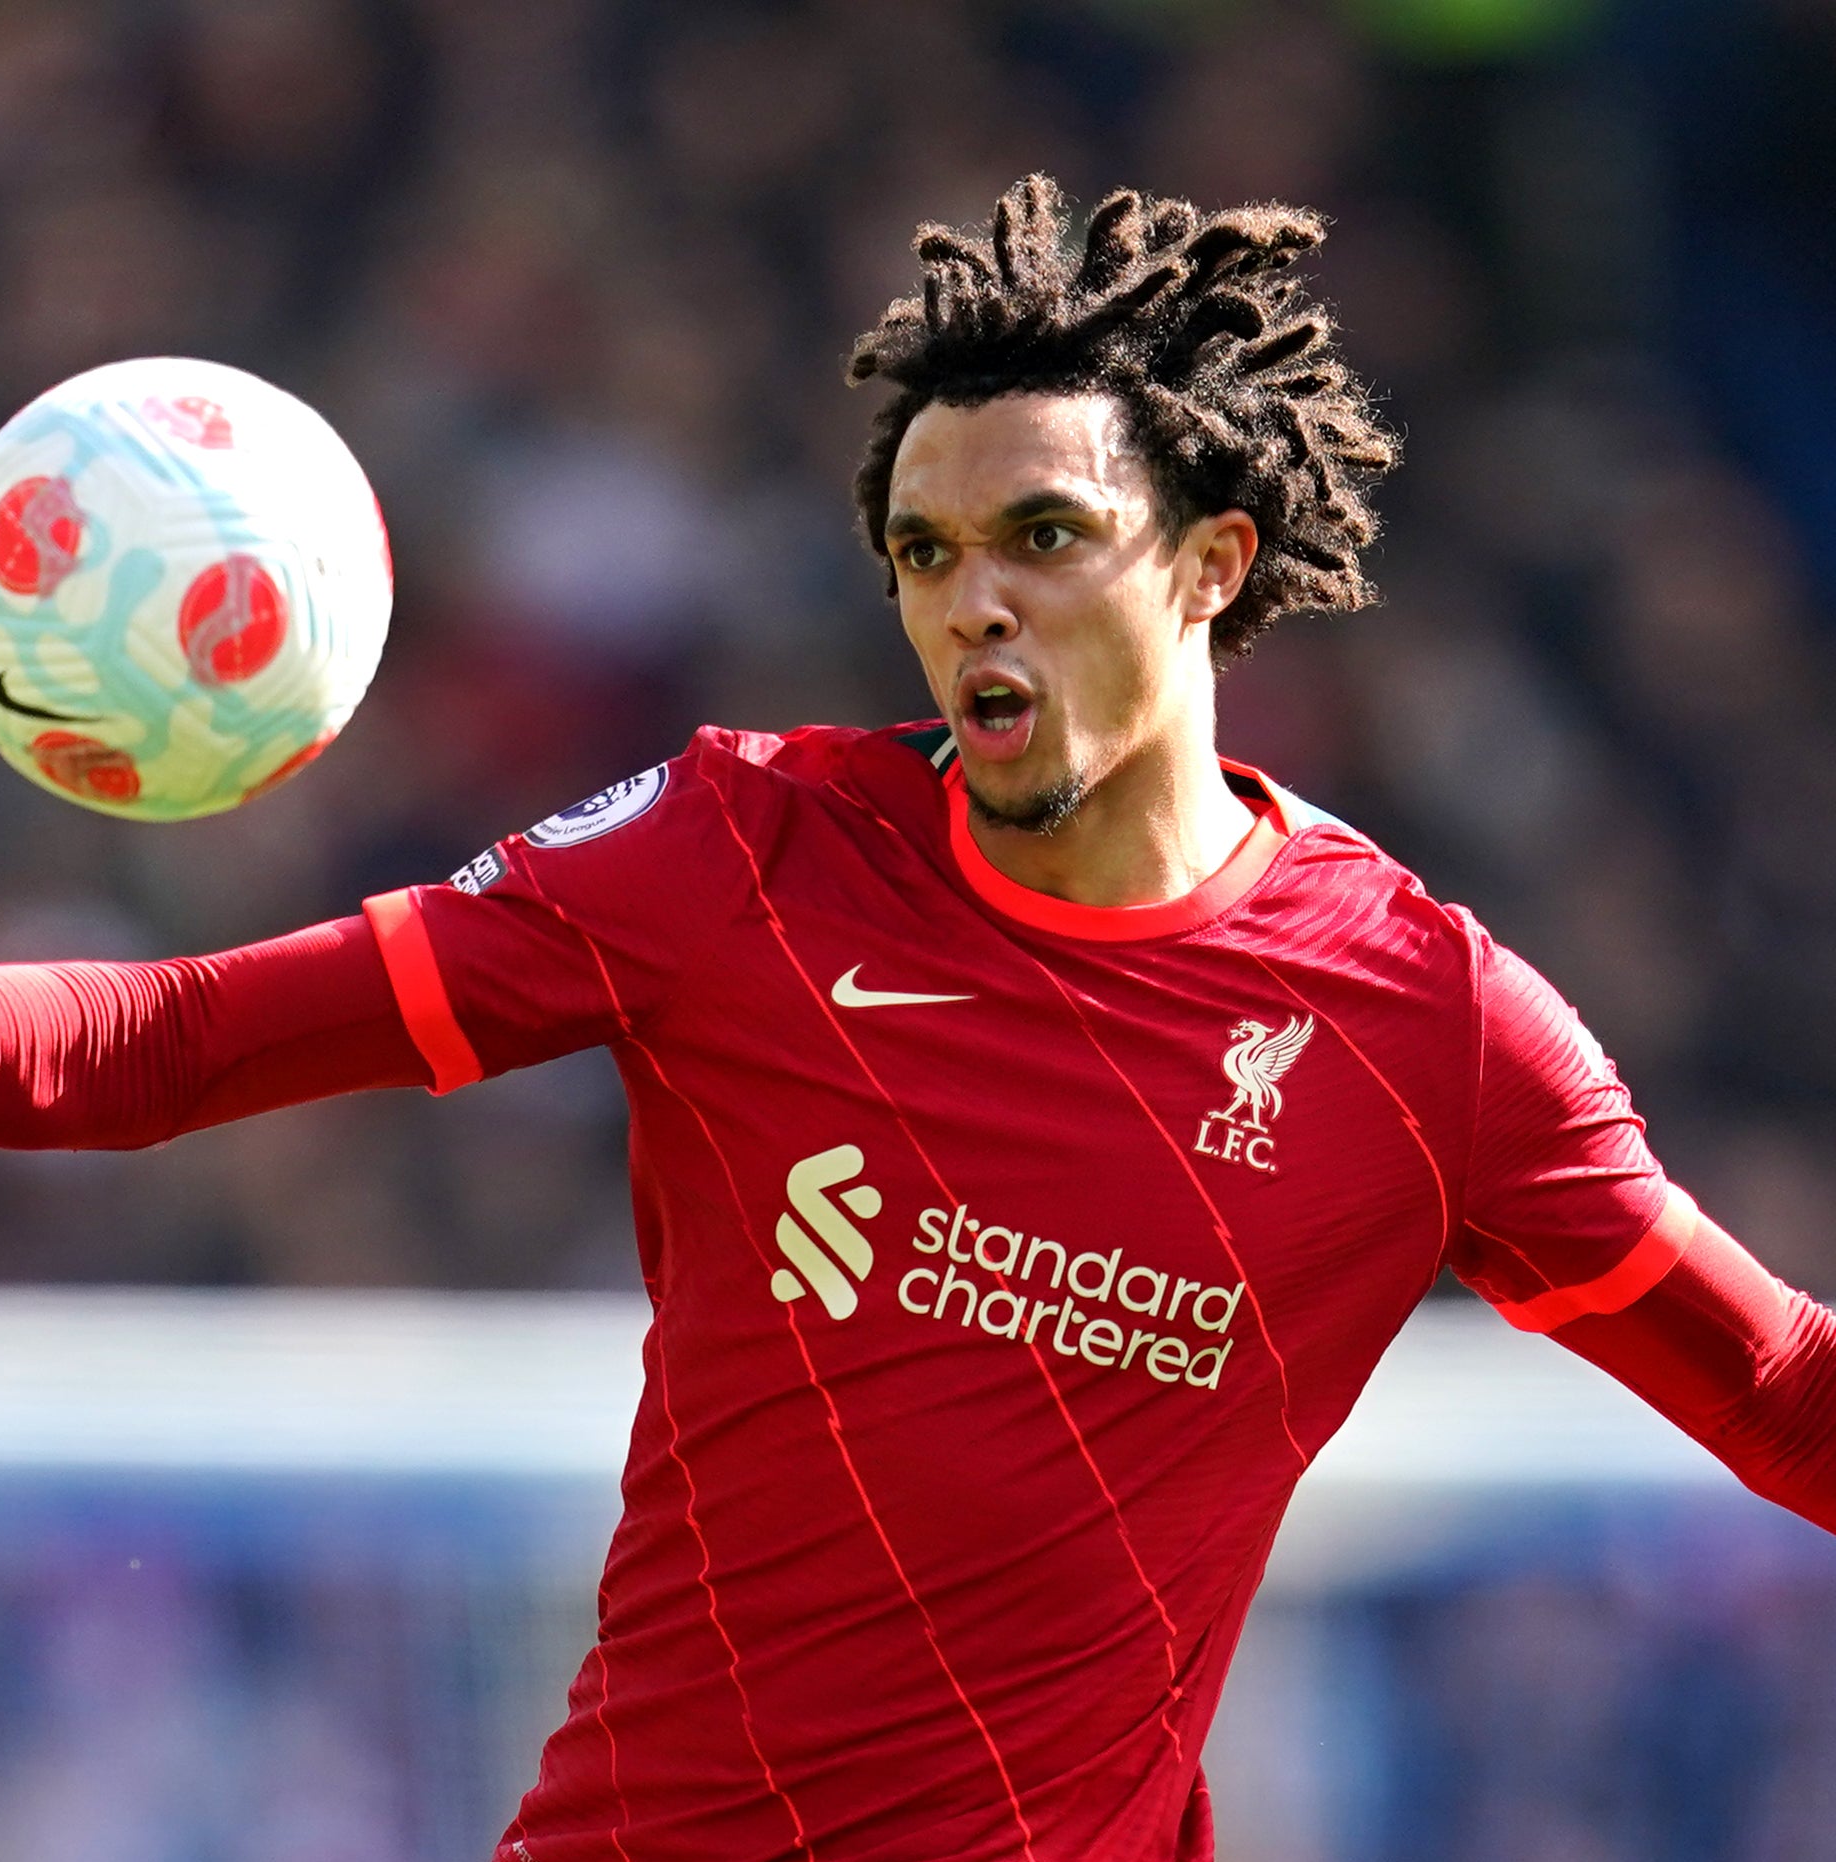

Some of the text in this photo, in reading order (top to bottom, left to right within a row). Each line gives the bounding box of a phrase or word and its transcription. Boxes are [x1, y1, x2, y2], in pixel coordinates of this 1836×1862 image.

[564, 817, 607, 836] League
[1195, 1120, 1276, 1171] L.F.C.
[912, 1204, 1245, 1333] standard
[898, 1265, 1234, 1390] chartered
